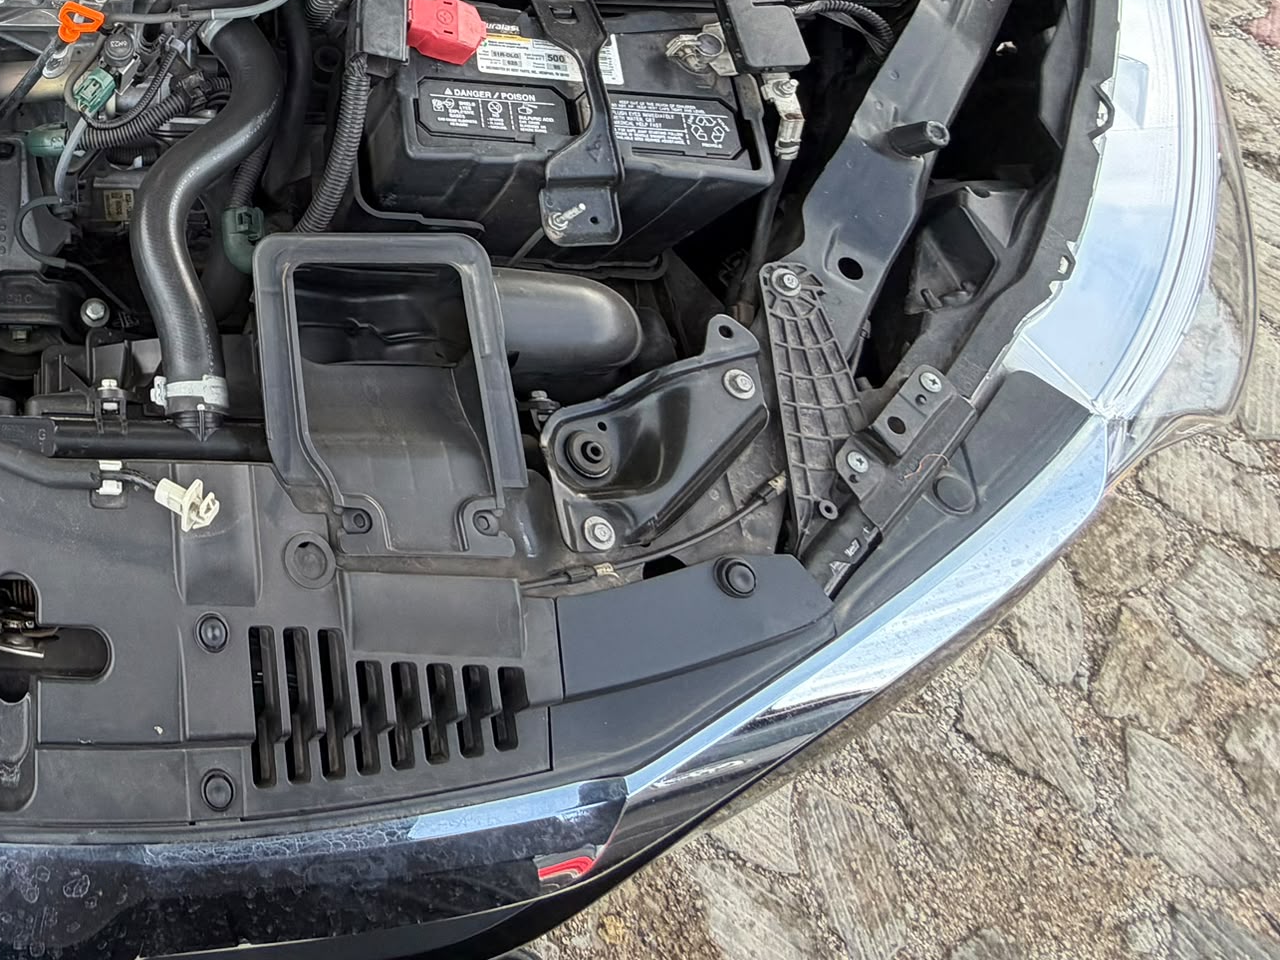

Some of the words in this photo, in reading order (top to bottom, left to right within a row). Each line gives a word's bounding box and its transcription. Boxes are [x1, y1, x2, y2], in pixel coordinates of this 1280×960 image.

[547, 54, 565, 63] 500
[453, 88, 492, 99] DANGER
[500, 92, 536, 101] POISON
